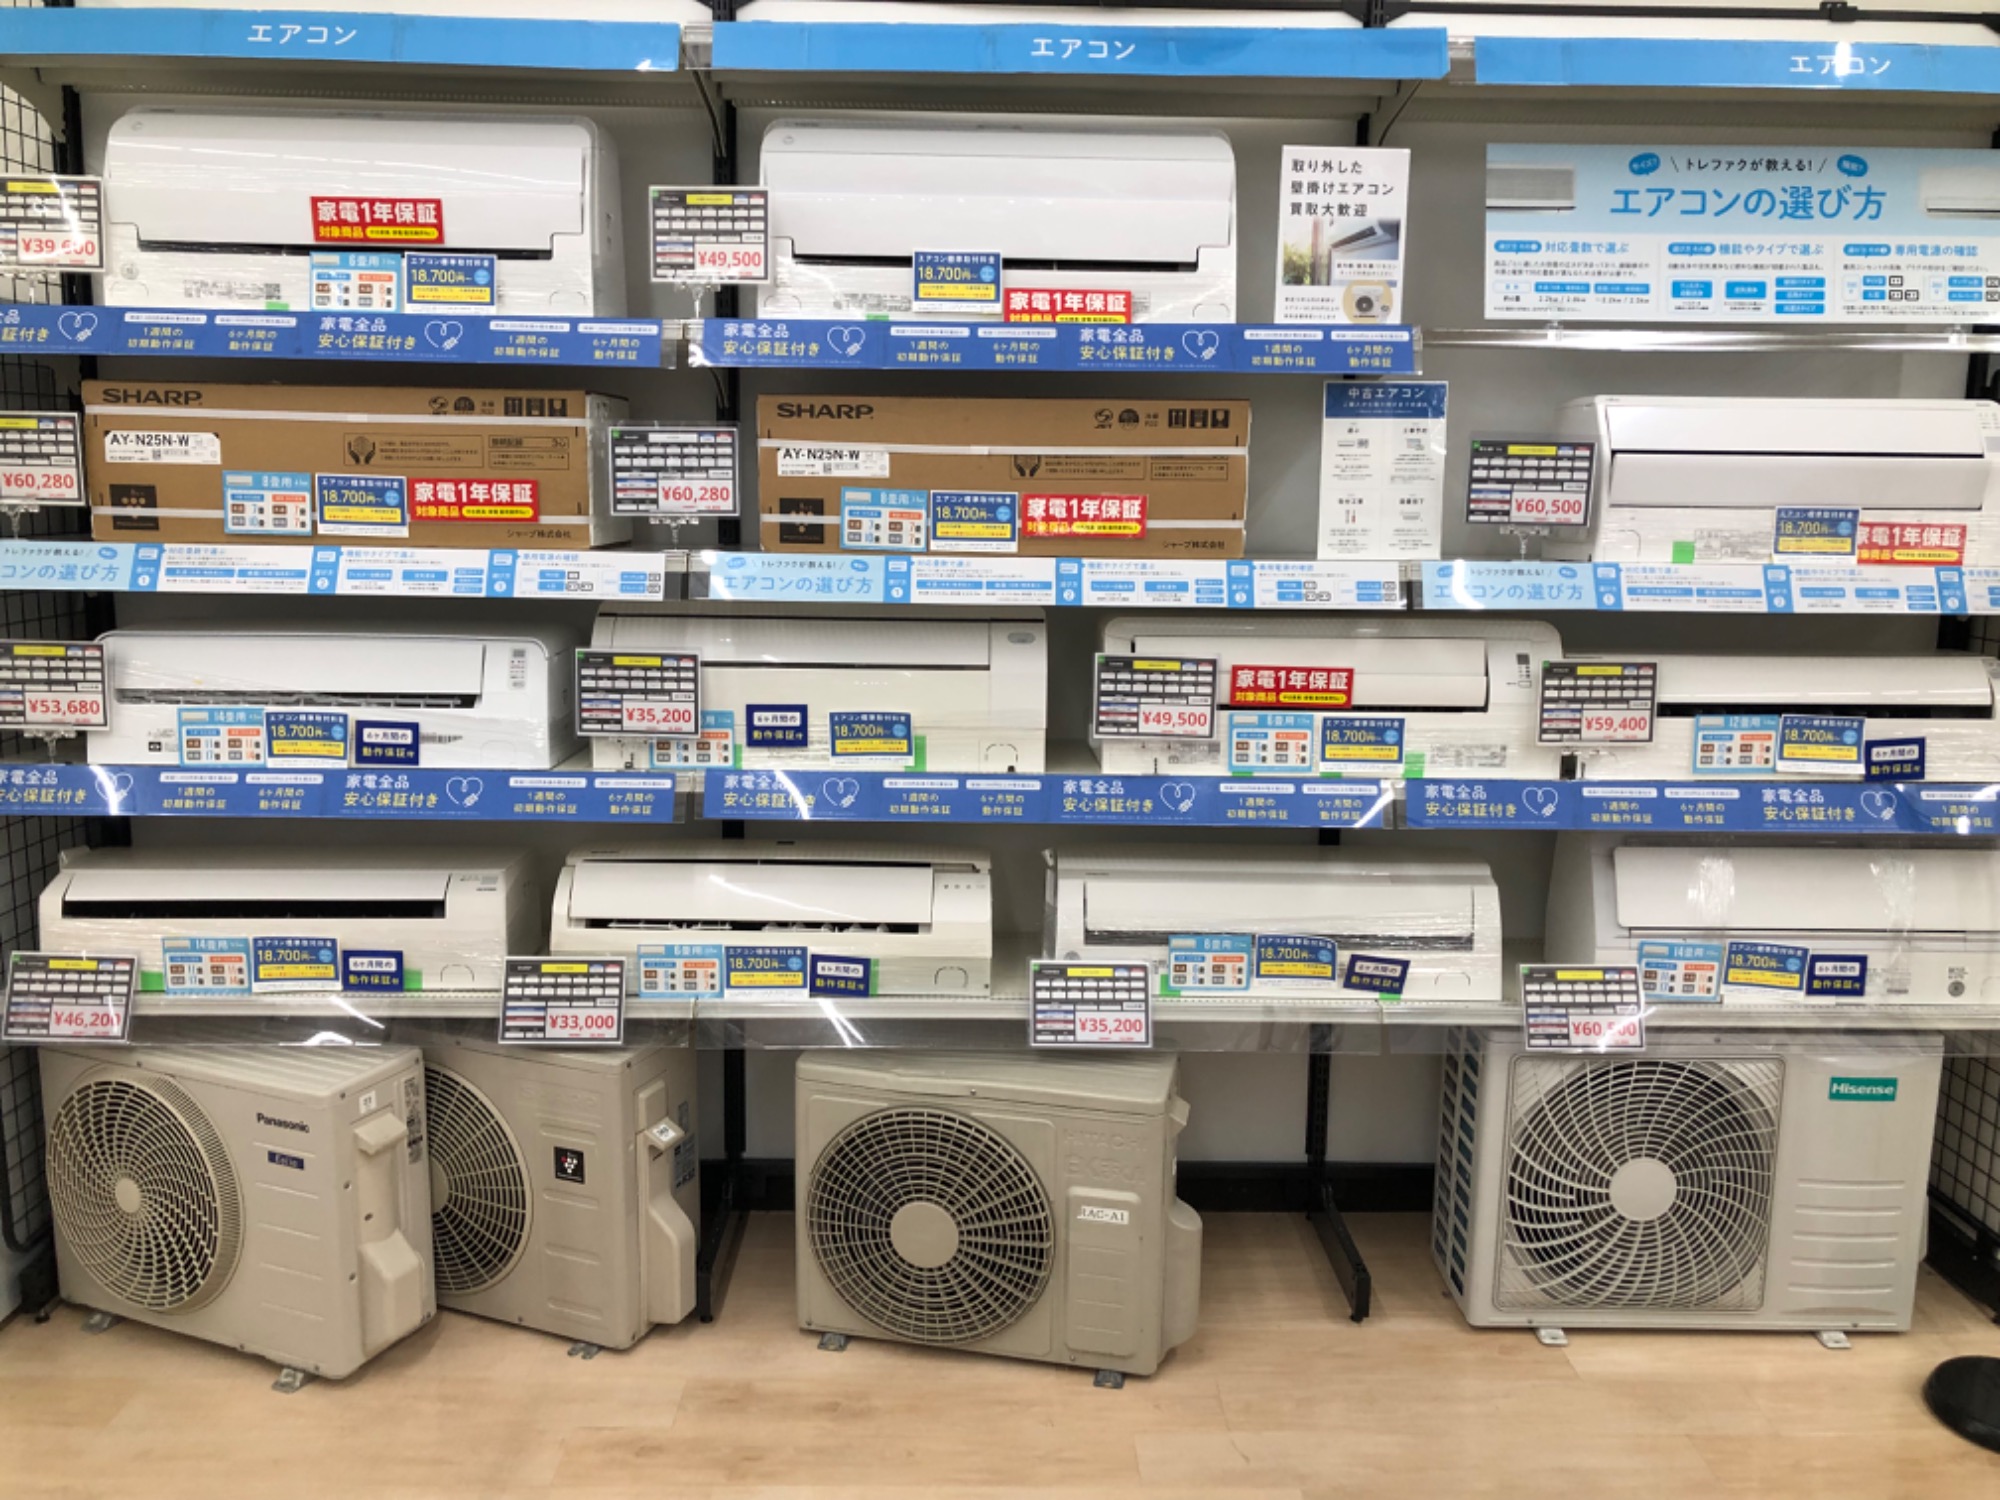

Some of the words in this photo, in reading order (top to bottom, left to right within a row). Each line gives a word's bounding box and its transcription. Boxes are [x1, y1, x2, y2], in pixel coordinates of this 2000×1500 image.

[247, 23, 358, 46] エアコン
[1030, 37, 1136, 61] エアコン
[1790, 55, 1892, 75] エアコン
[1291, 158, 1362, 174] 取り外した
[1686, 158, 1812, 172] トレファクが教える!
[1291, 180, 1394, 195] 壁掛けエアコン
[1290, 202, 1368, 217] 買取大歓迎
[1610, 184, 1887, 220] エアコンの選び方
[317, 201, 437, 224] 家電1年保証
[319, 226, 364, 239] 対象商品
[21, 238, 96, 258] ¥39600
[1545, 241, 1629, 253] 対応畳数で選ぶ
[1719, 244, 1824, 256] 機能やタイプで選ぶ
[1895, 244, 1978, 257] 専用電源の確認
[698, 250, 761, 269] ¥49,500
[1009, 291, 1126, 312] 家電1年保証
[320, 318, 387, 332] 家電全品
[724, 323, 789, 338] 家電全品
[318, 335, 416, 350] 安心保証付き
[1080, 329, 1144, 343] 家電全品
[723, 341, 820, 356] 安心保証付き
[1080, 347, 1175, 361] 安心保証付き
[102, 388, 202, 405] SHARP
[1348, 387, 1425, 399] 中古エアコン
[777, 403, 873, 419] SHARP
[110, 433, 190, 447] AY-N25N-W
[783, 449, 860, 461] AY-N25N-W
[3, 472, 75, 491] ¥60,280
[414, 482, 533, 503] 家電1年保証
[662, 486, 729, 504] ¥60,280
[416, 505, 459, 518] 対象商品
[1027, 498, 1142, 519] 家電1年保証
[1515, 498, 1582, 516] ¥60,500
[508, 529, 571, 539] シャープ株式会社
[1163, 540, 1225, 549] シャープ株式会社
[724, 575, 873, 594] エアコンの選び方
[1434, 583, 1584, 601] エコンの選び方
[1236, 669, 1348, 689] 家電1年保証
[28, 698, 101, 715] ¥53,680
[625, 707, 692, 725] ¥35,200
[1142, 712, 1207, 729] ¥49,500
[1585, 716, 1647, 732] ¥59,400
[346, 774, 409, 789] 家電全品
[1063, 780, 1124, 795] 家電全品
[1424, 784, 1487, 799] 家電全品
[1761, 789, 1825, 804] 家電全品
[344, 793, 439, 807] 安心保証付き
[1062, 798, 1153, 813] 安心保証付き
[1425, 803, 1517, 817] 安心保証付き
[1763, 806, 1855, 821] 安心保証付き
[54, 1010, 122, 1029] ¥46,200
[549, 1013, 615, 1031] ¥33,000
[1078, 1017, 1143, 1034] ¥35,200
[1831, 1083, 1894, 1095] Hisense
[256, 1112, 310, 1134] Panasonic
